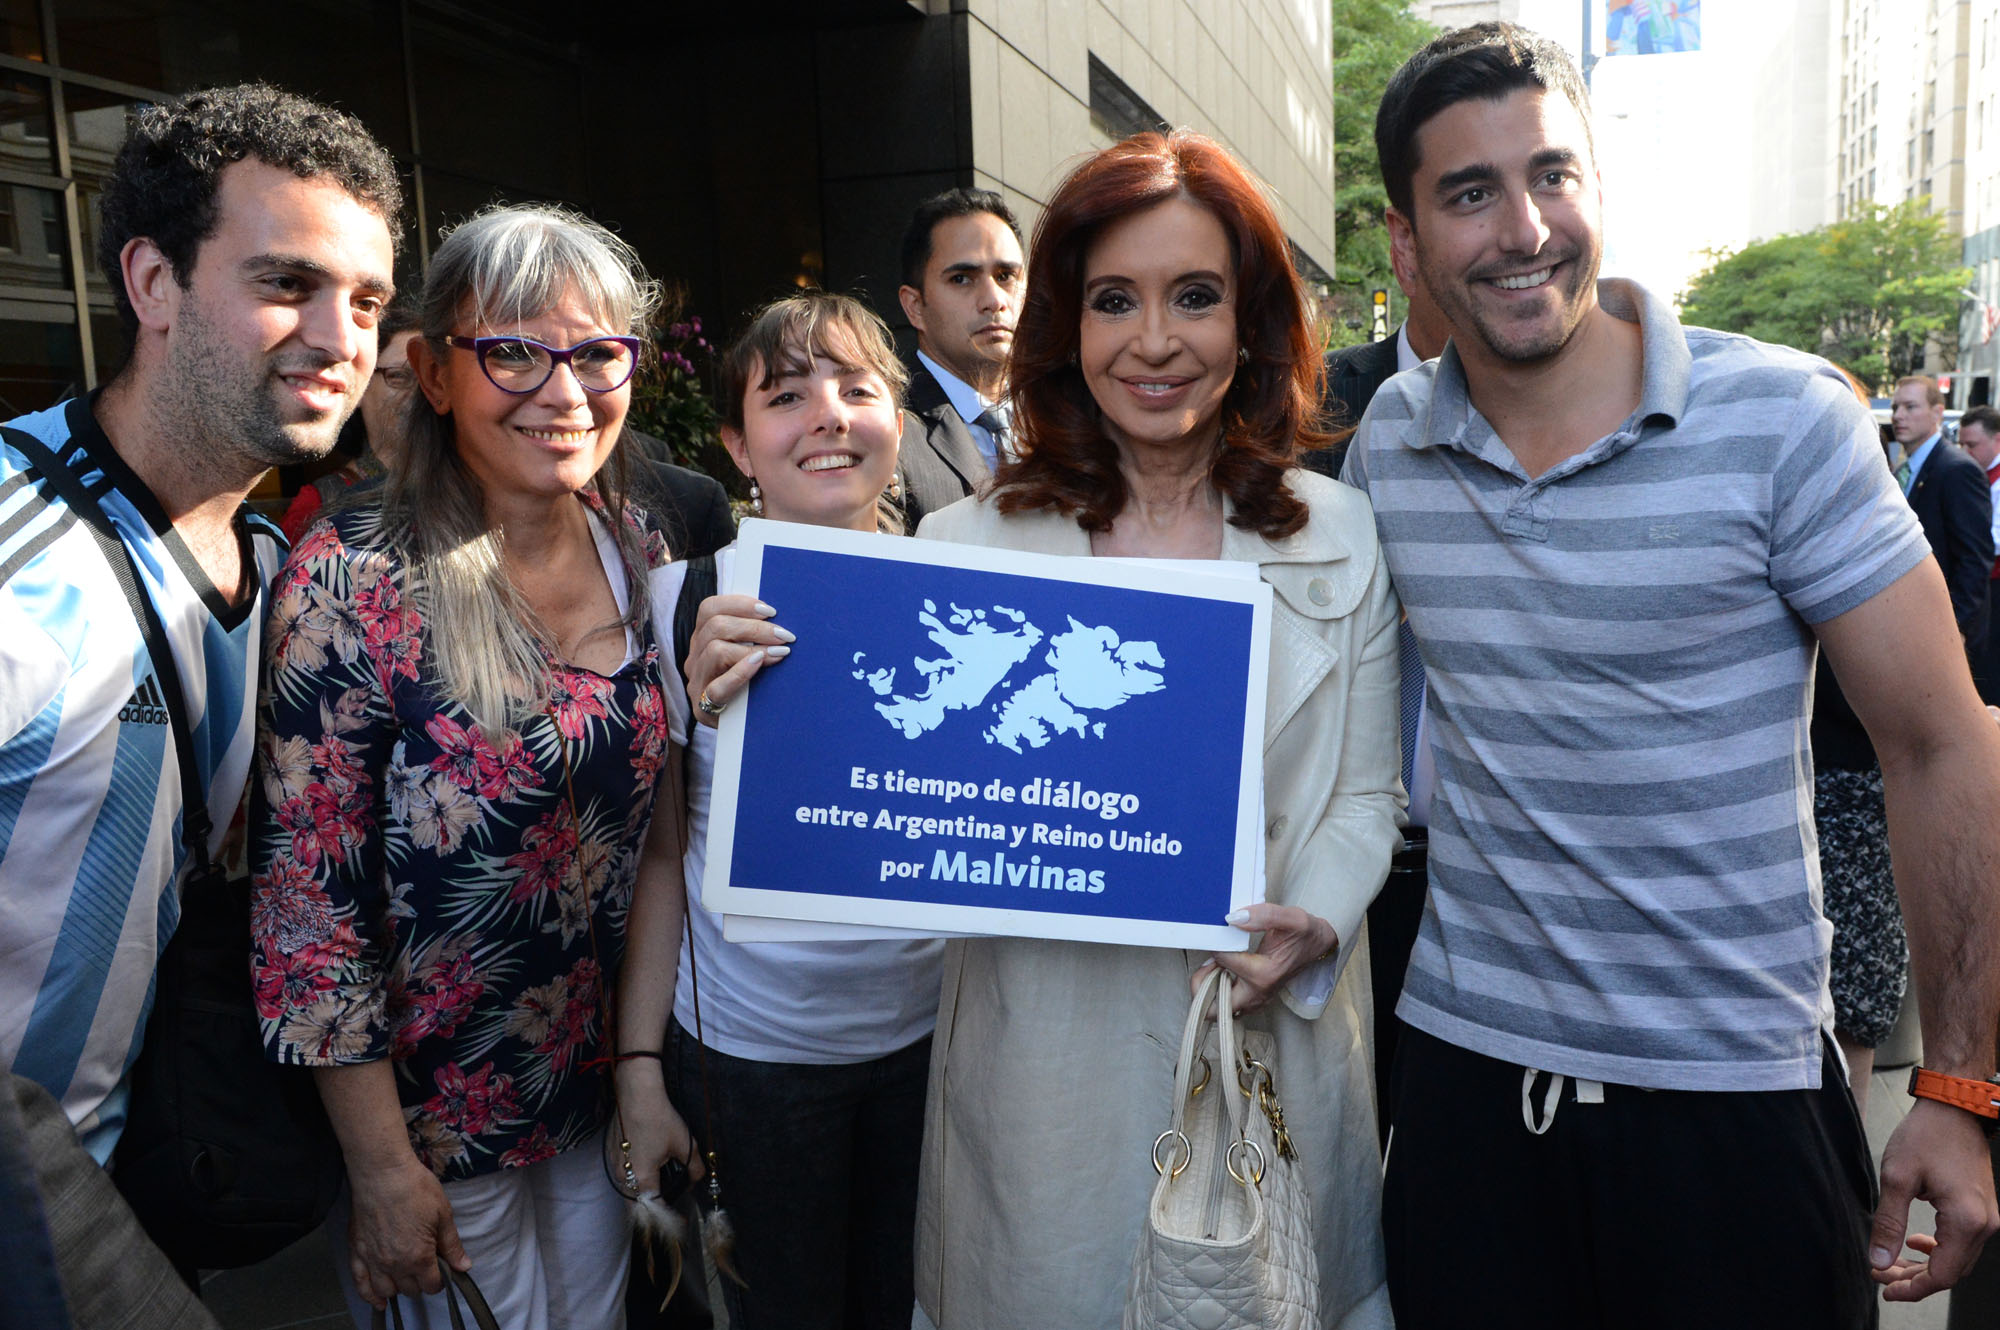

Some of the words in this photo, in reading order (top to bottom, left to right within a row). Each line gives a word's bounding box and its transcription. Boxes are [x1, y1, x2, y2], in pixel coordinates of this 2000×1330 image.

[118, 703, 169, 725] adidas
[850, 766, 879, 791] Es
[883, 769, 979, 804] tiempo
[983, 778, 1016, 804] de
[1020, 777, 1140, 821] diálogo
[795, 805, 868, 829] entre
[873, 807, 1006, 842] Argentina
[1010, 825, 1027, 848] y
[1031, 822, 1104, 850] Reino
[1109, 829, 1183, 857] Unido
[880, 860, 925, 882] por
[930, 849, 1106, 895] Malvinas
